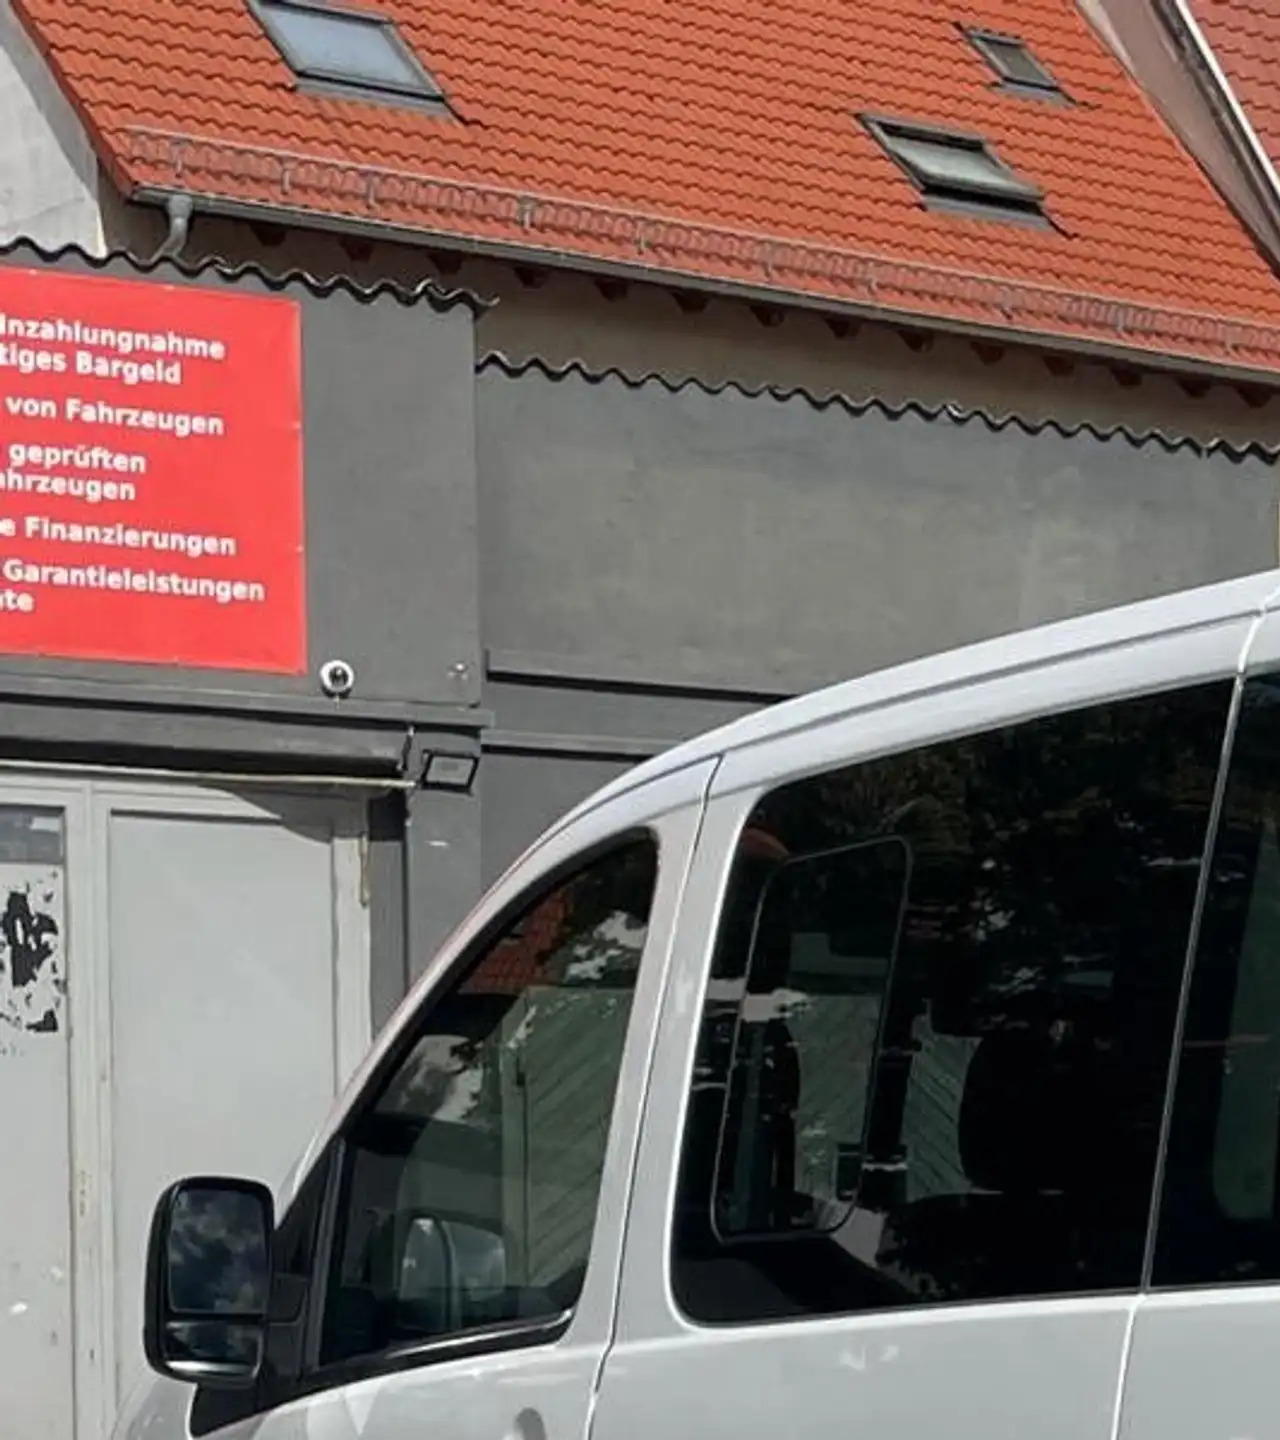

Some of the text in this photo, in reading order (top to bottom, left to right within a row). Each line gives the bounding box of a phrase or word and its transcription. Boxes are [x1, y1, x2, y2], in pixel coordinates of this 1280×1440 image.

[0, 312, 226, 360] Inzahlungnahme
[76, 350, 182, 385] Bargeld
[5, 396, 225, 437] von Fahrzeugen
[9, 443, 146, 474] geprüften
[25, 516, 237, 558] Finanzierungen
[3, 558, 265, 604] Garantieleistungen
